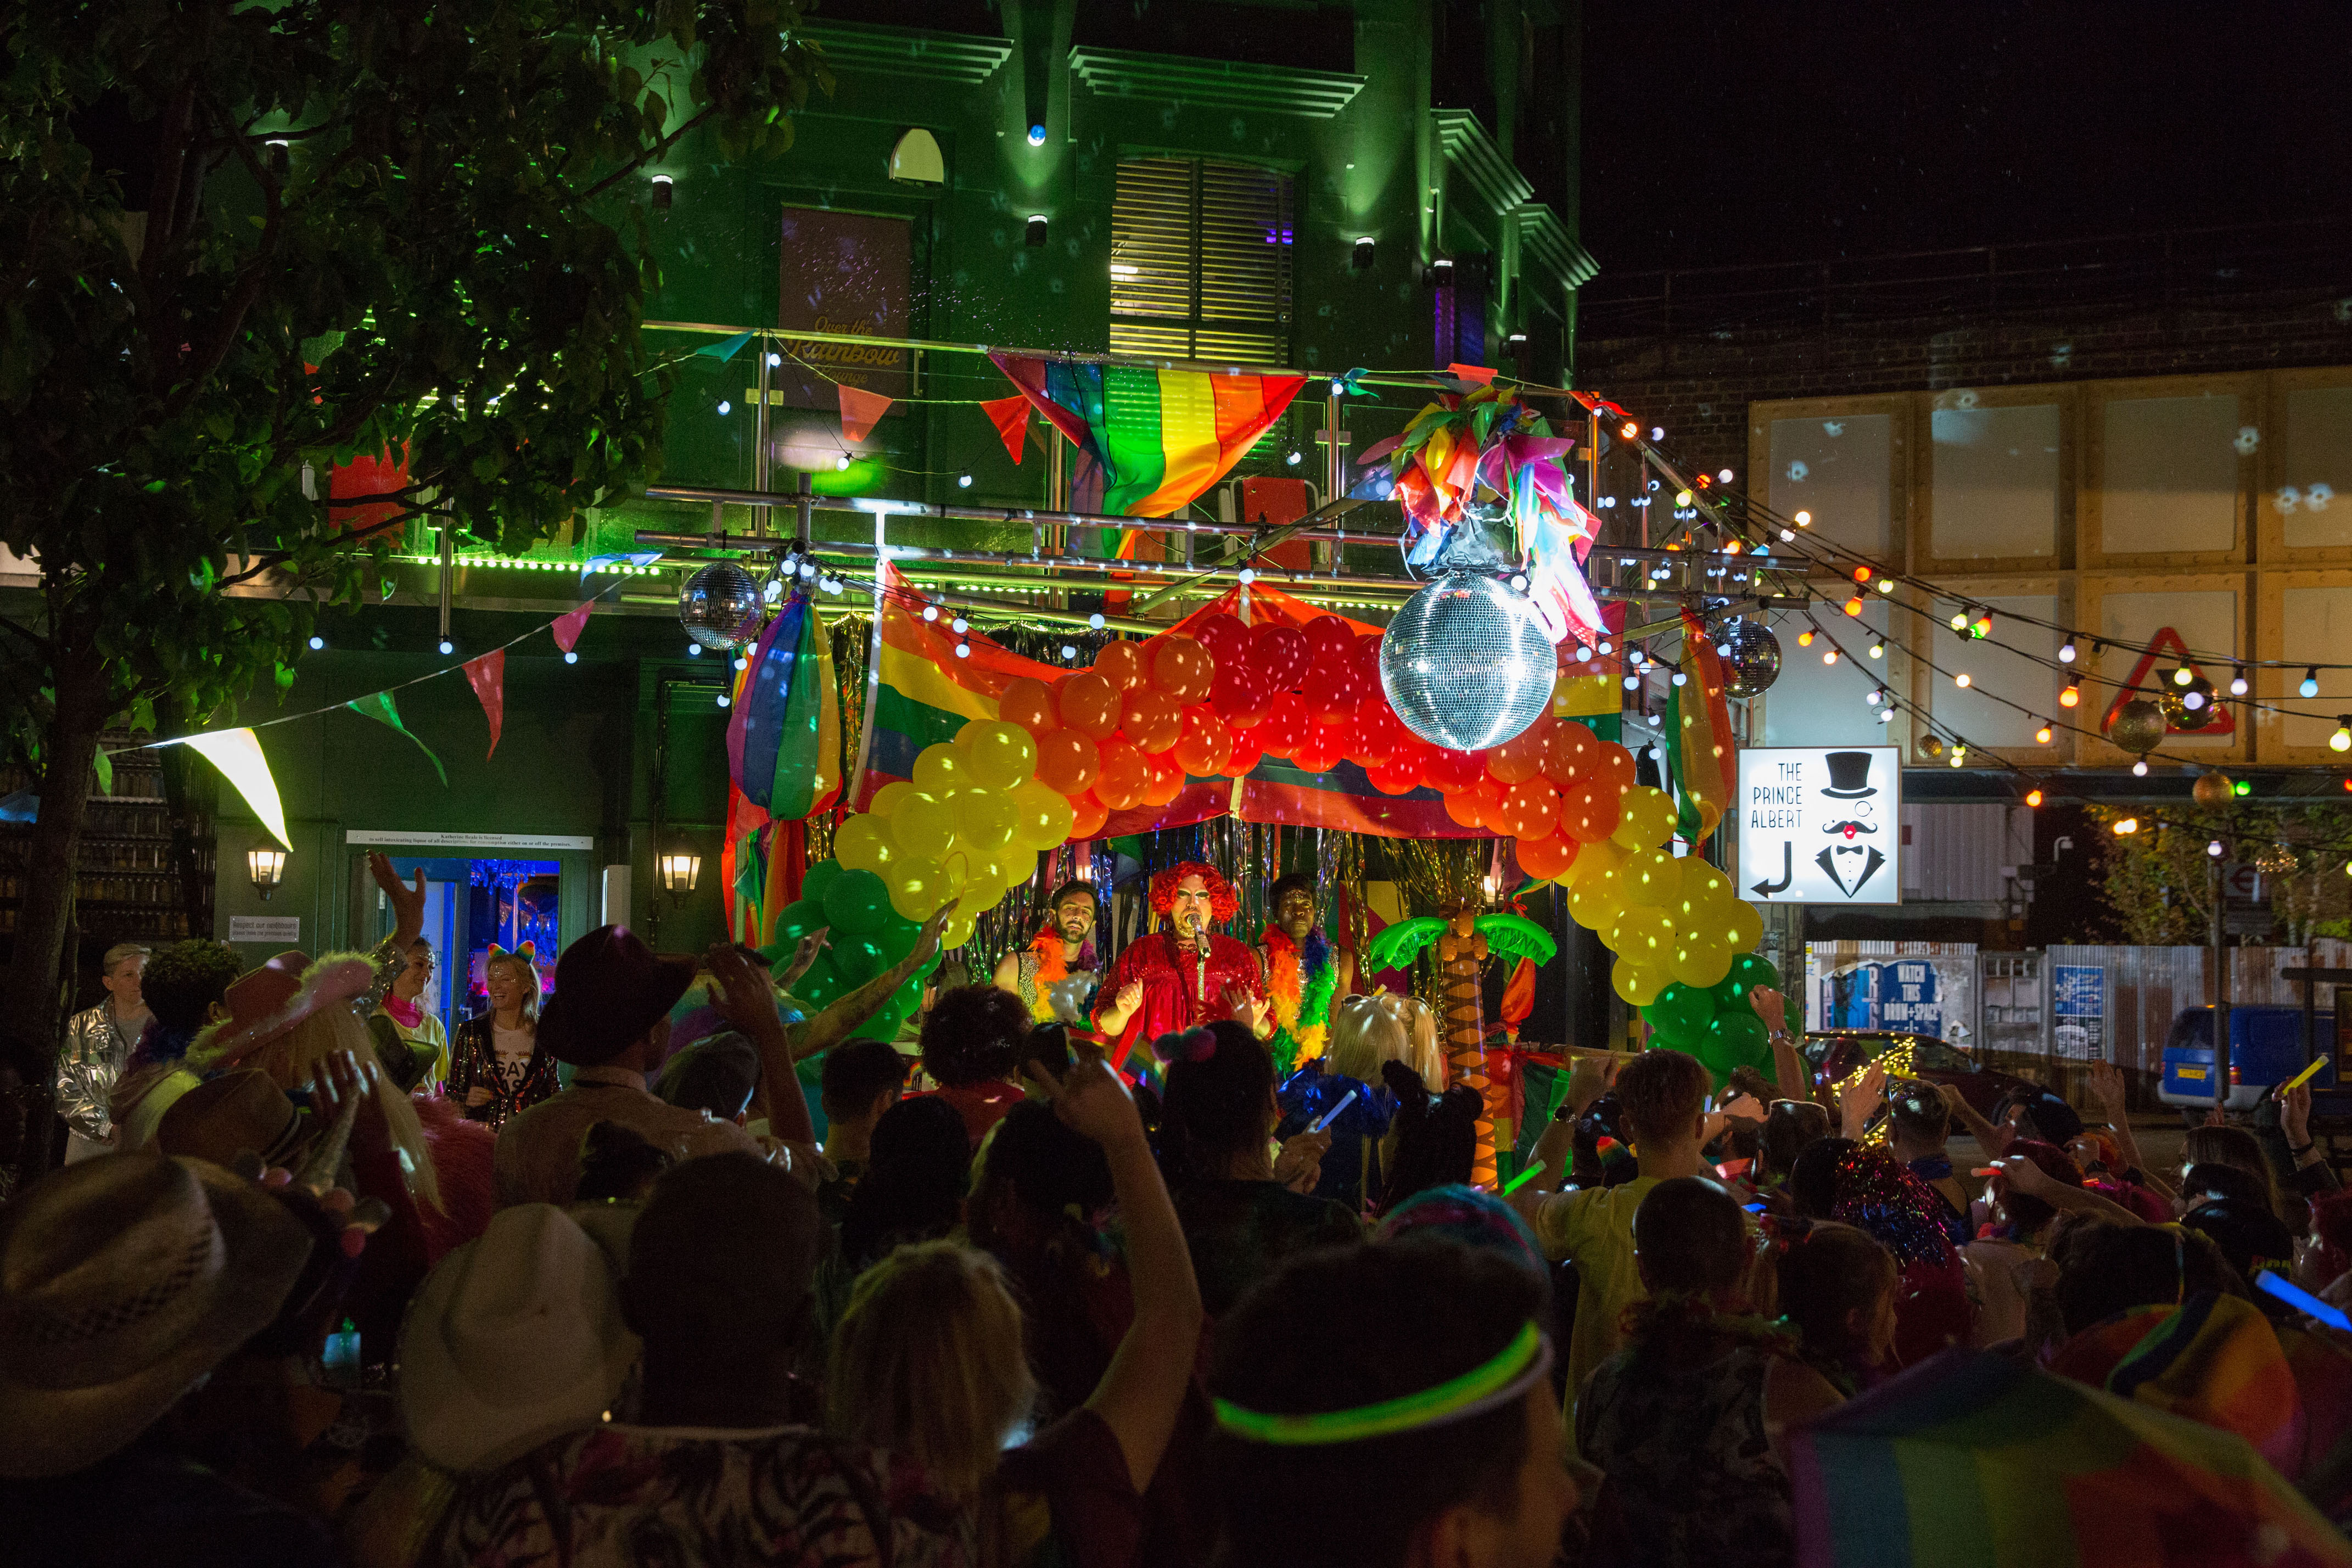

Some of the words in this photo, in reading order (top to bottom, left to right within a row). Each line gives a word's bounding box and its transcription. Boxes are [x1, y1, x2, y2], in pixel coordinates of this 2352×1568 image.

[815, 316, 848, 333] Over
[850, 318, 873, 336] the
[787, 338, 900, 366] Rainbow
[1778, 763, 1802, 781] THE
[1754, 786, 1802, 805] PRINCE
[1751, 809, 1802, 828] ALBERT
[1897, 965, 1925, 983] WATCH
[1902, 984, 1921, 1002] THIS
